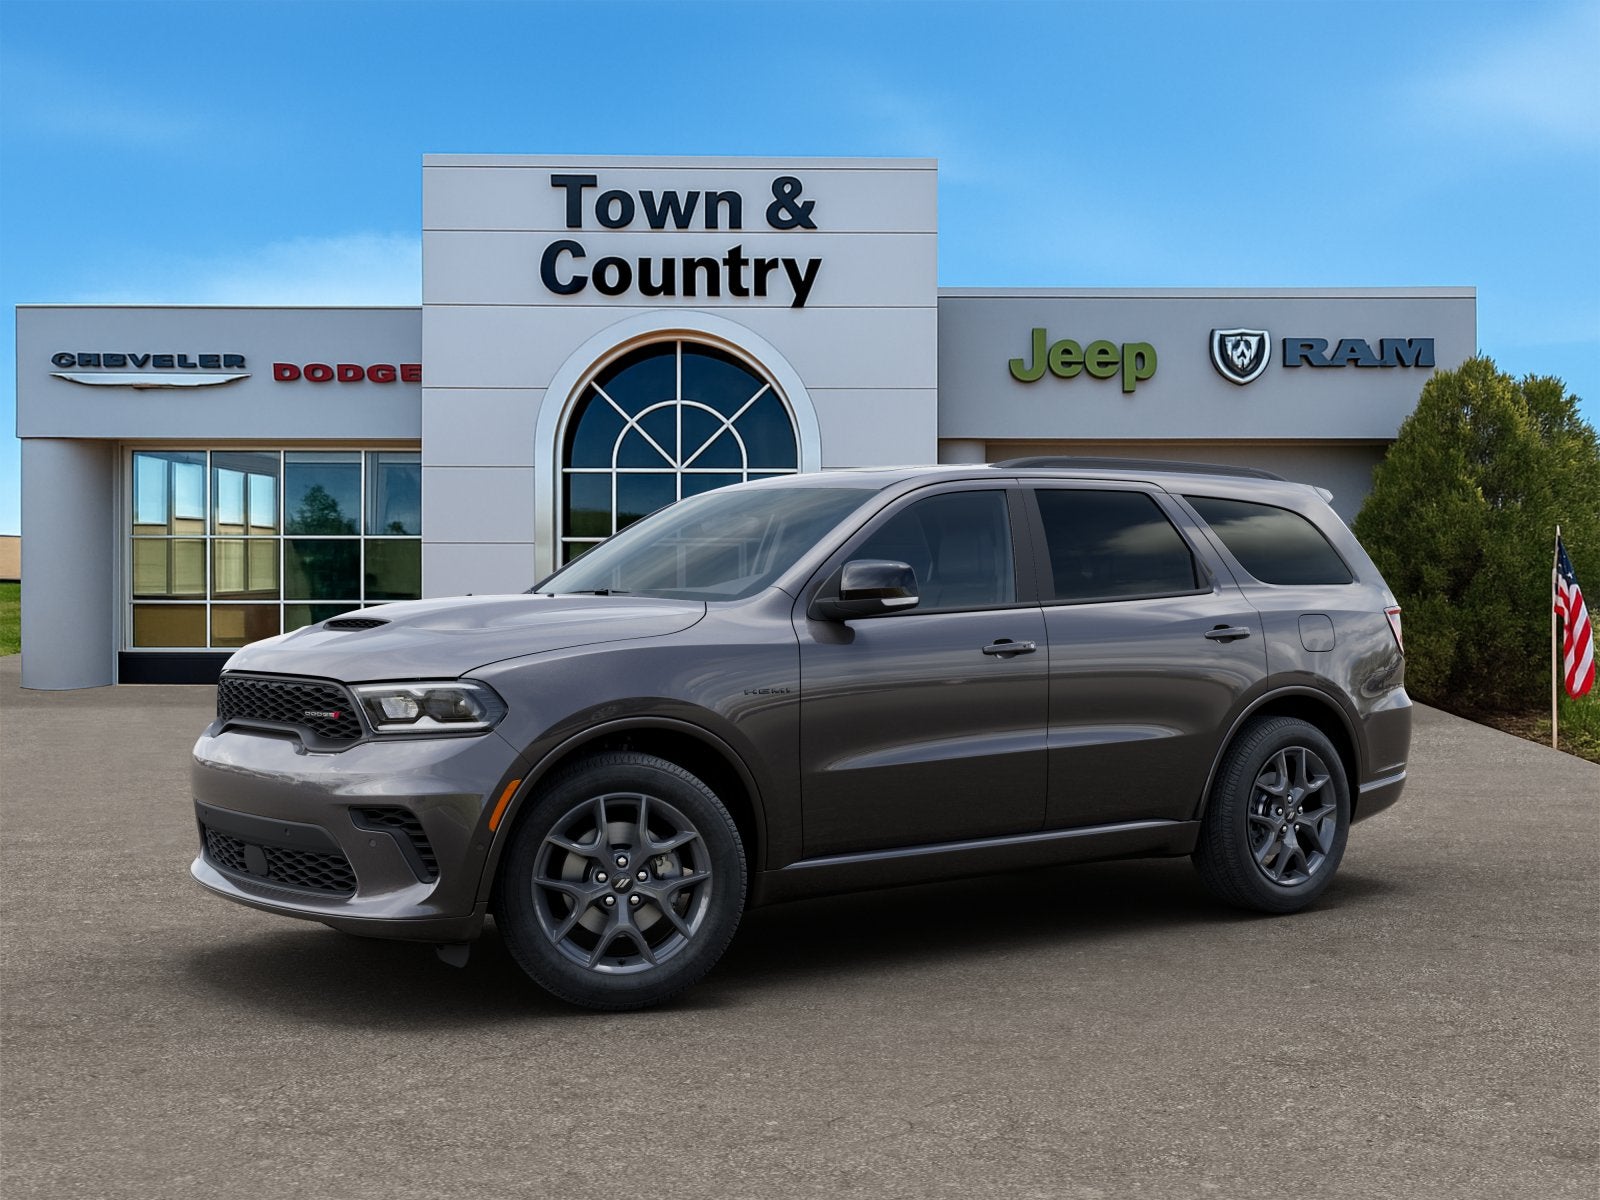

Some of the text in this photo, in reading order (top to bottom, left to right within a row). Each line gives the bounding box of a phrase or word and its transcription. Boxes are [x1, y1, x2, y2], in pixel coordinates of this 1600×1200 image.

[550, 174, 818, 229] Town &
[540, 239, 822, 308] Country
[273, 363, 422, 383] DODGE
[1009, 328, 1157, 393] Jeep
[1282, 337, 1435, 368] RAM
